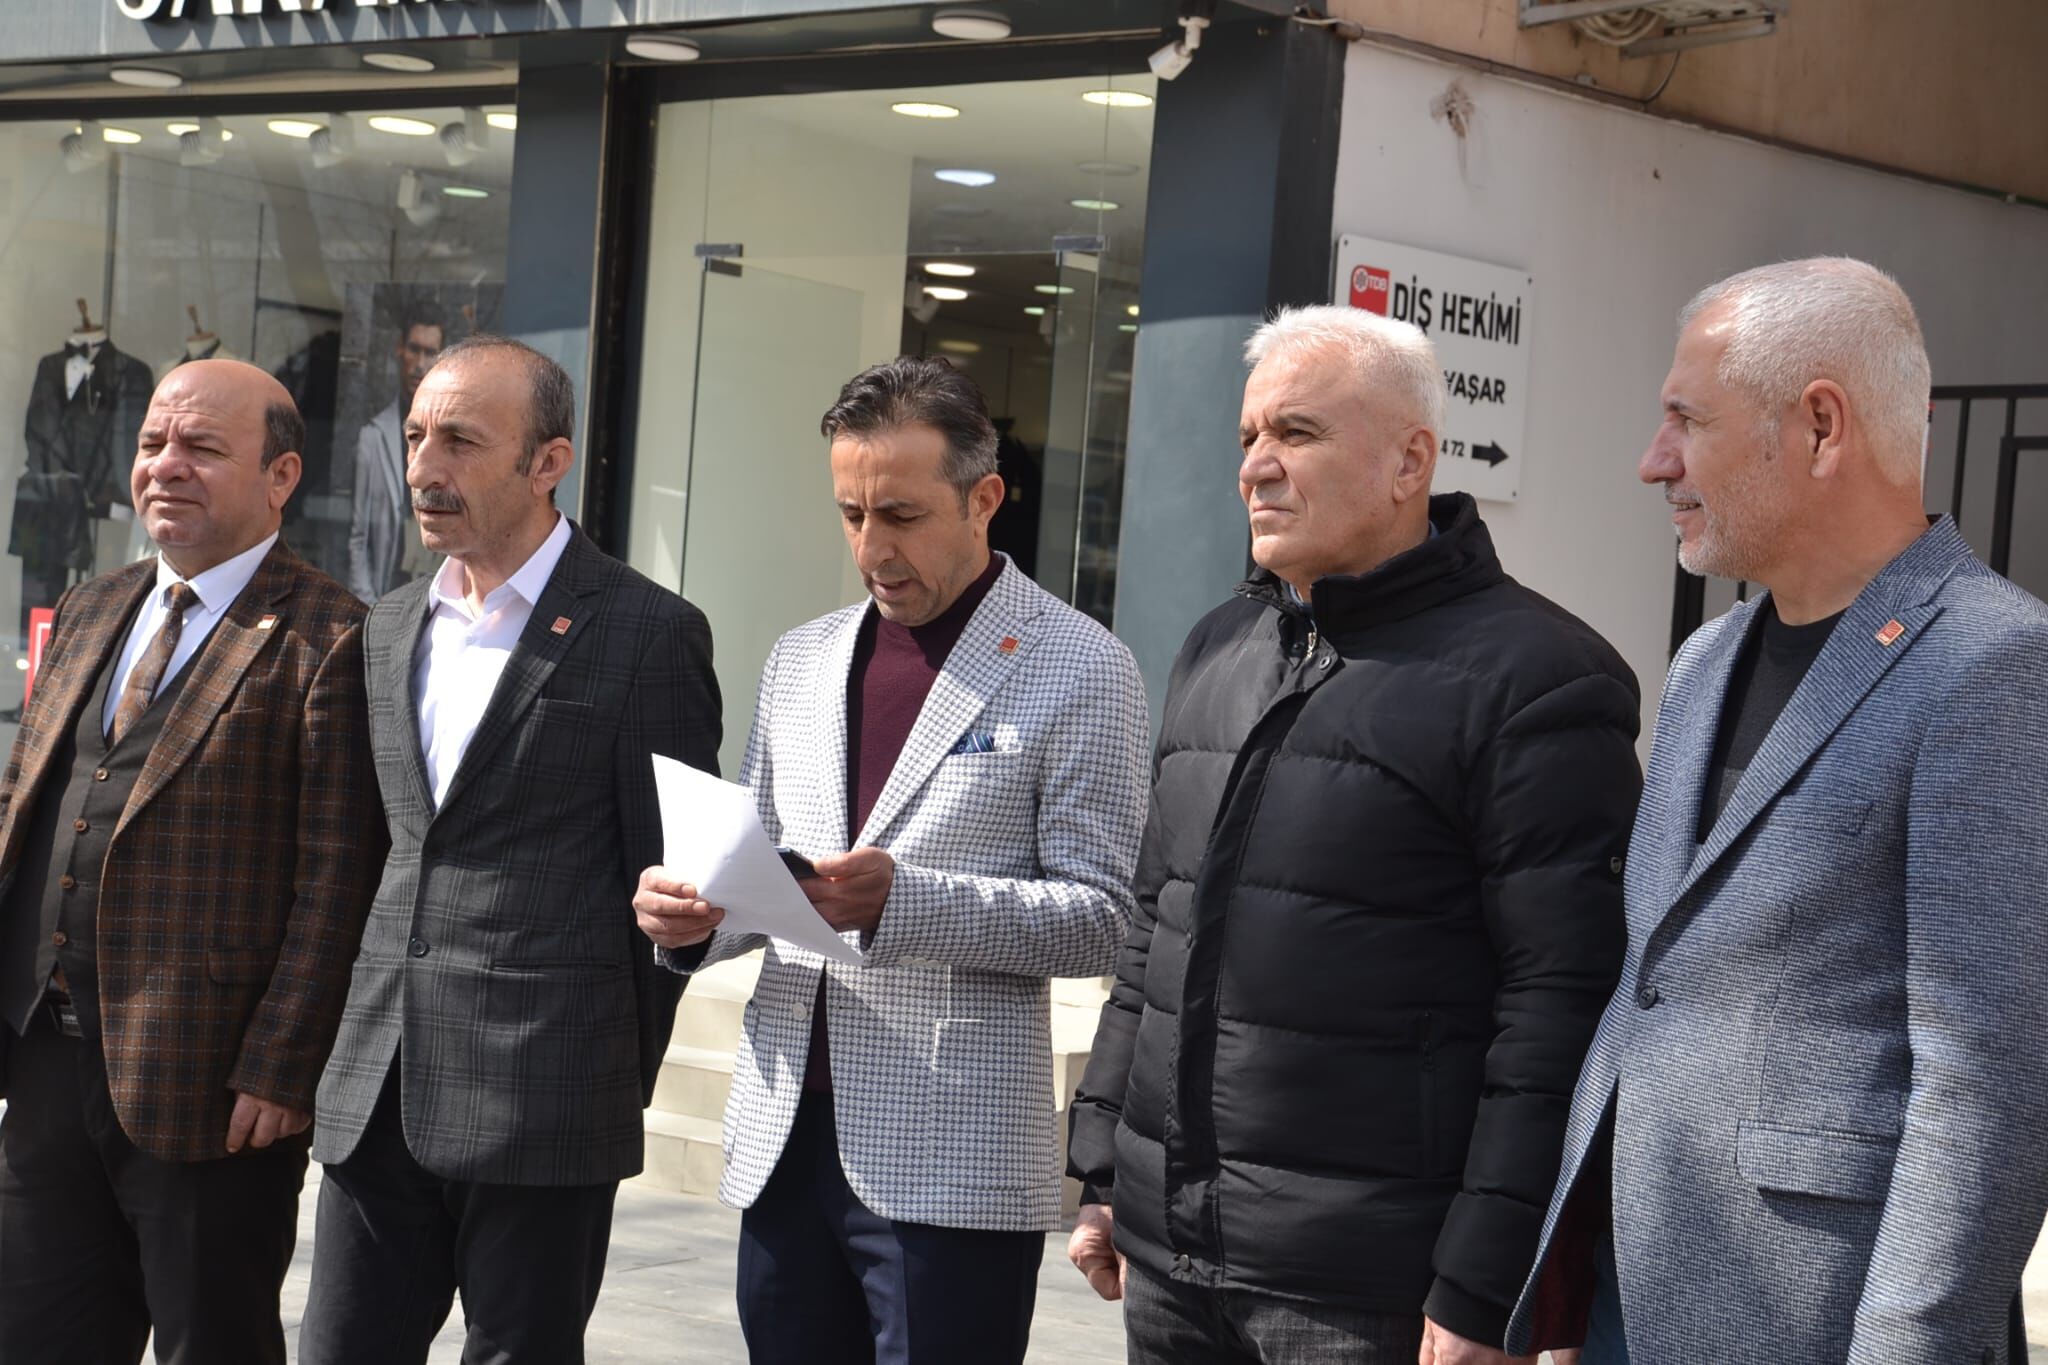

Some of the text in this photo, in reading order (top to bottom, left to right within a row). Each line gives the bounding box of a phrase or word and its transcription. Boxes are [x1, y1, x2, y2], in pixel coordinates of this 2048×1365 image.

[1393, 274, 1521, 346] DİŞ HEKİMİ
[1443, 369, 1506, 405] YAŞAR
[1451, 440, 1465, 457] 72
